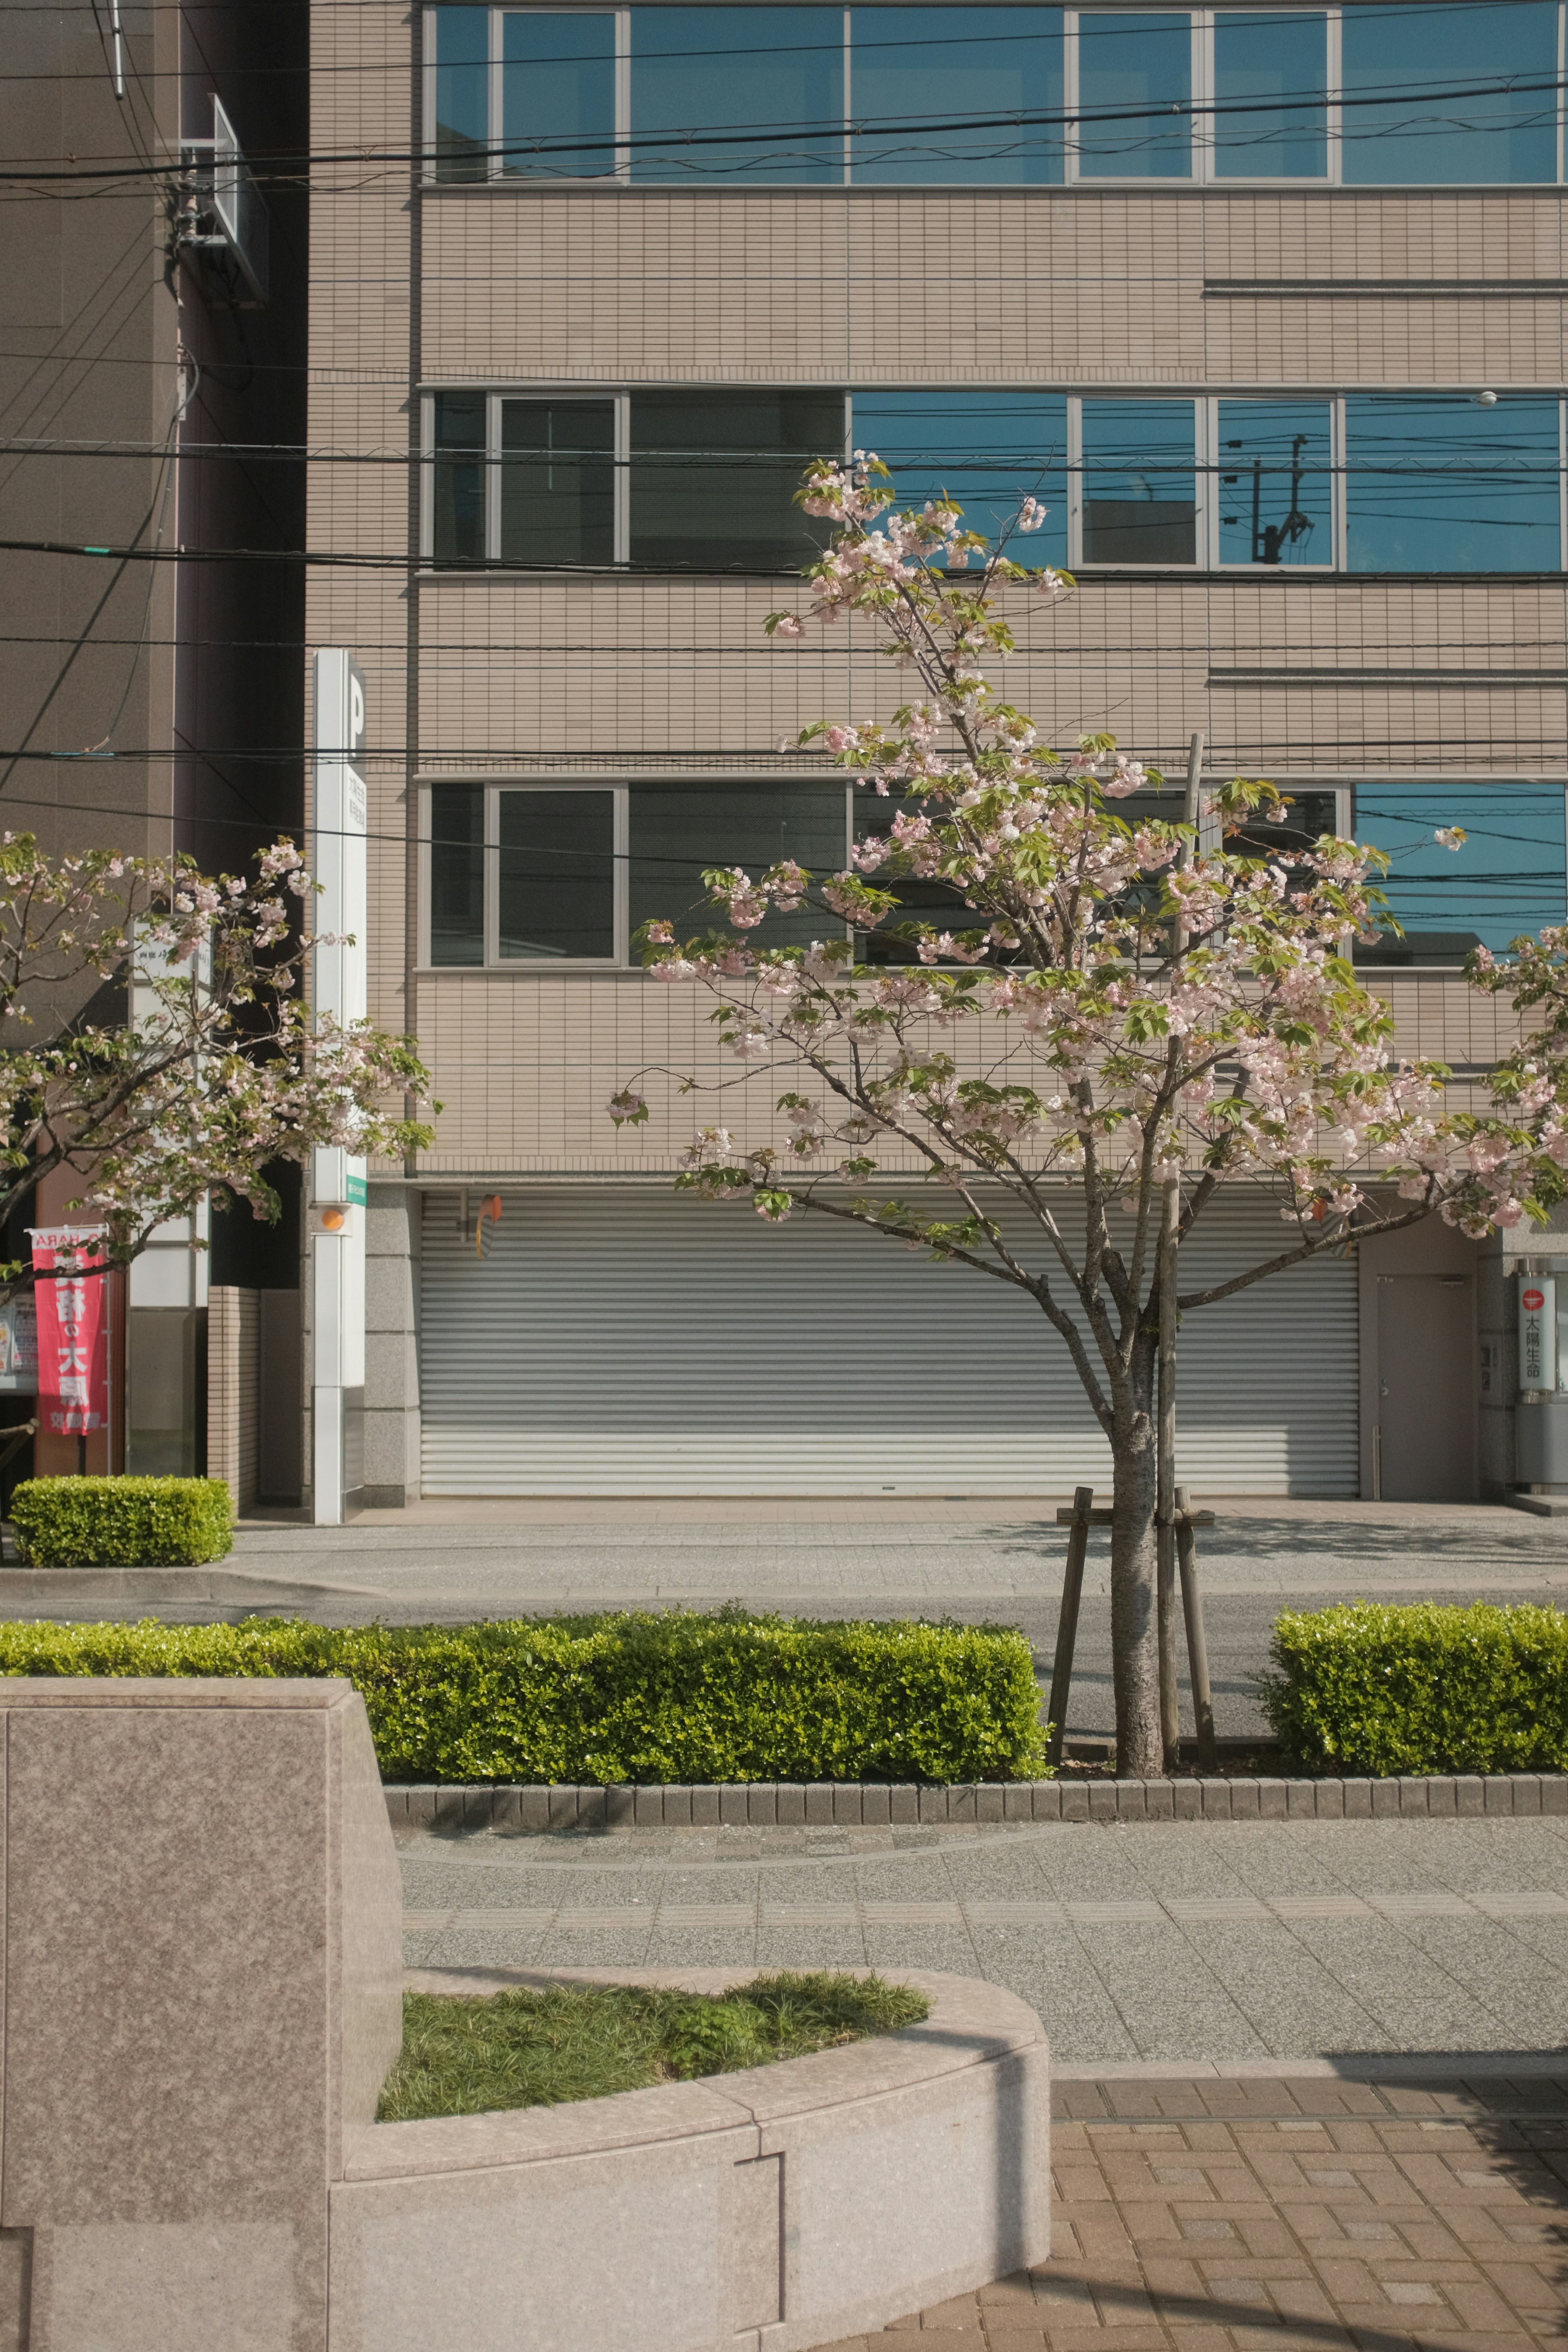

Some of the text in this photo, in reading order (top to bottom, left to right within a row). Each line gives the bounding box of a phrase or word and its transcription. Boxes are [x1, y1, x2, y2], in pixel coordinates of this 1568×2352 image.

[351, 673, 364, 758] P
[1526, 1316, 1540, 1378] 太陽生命
